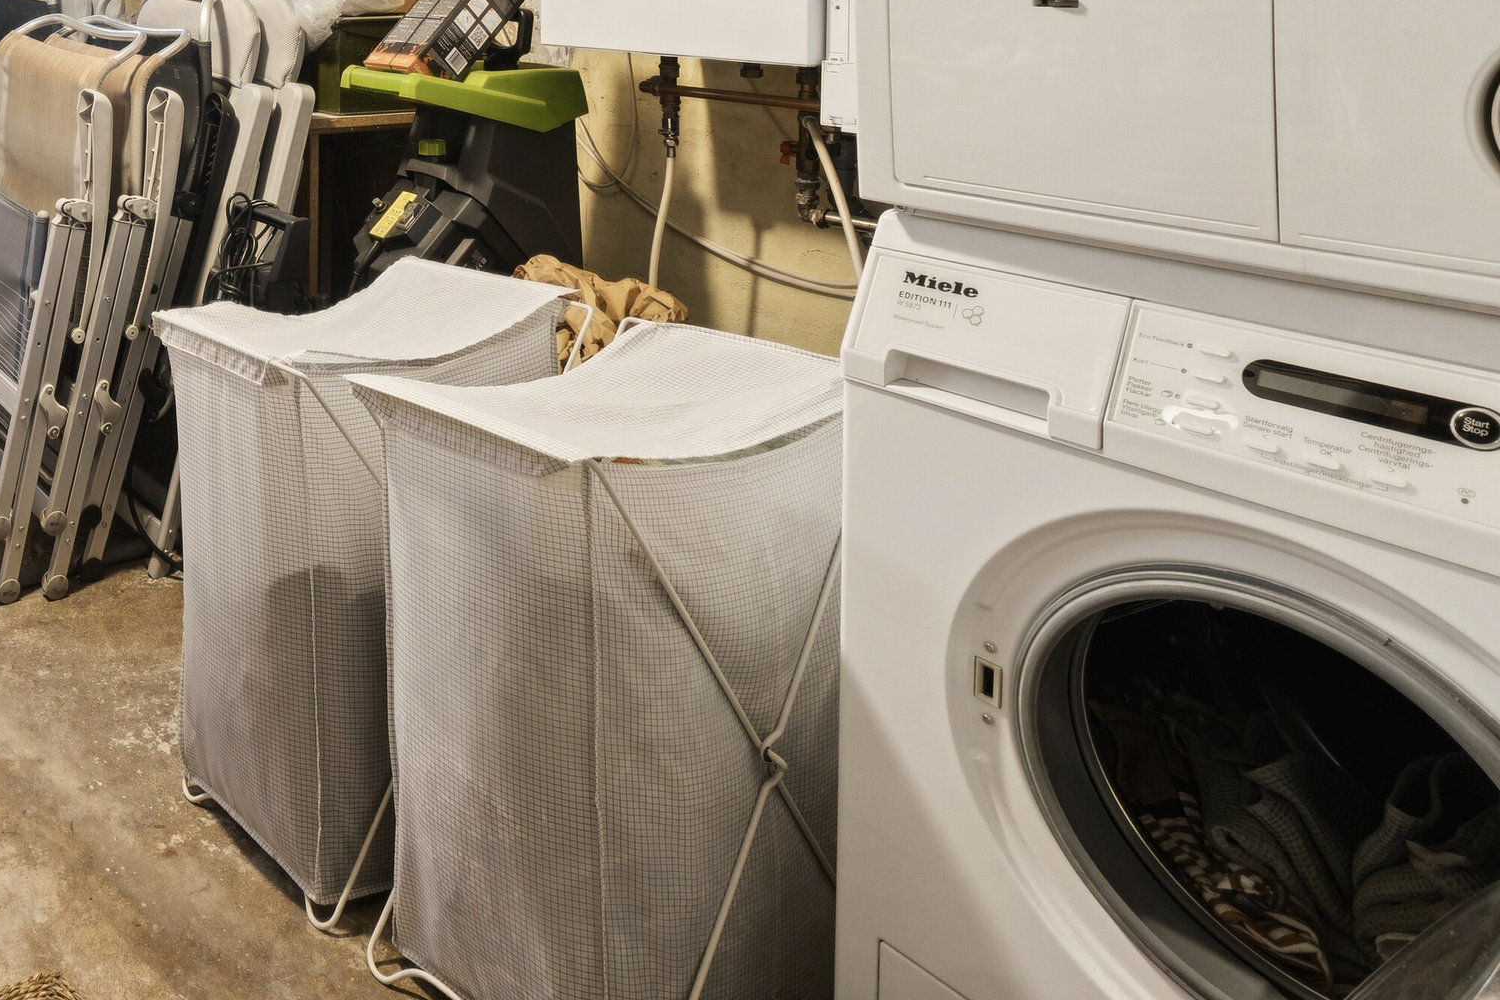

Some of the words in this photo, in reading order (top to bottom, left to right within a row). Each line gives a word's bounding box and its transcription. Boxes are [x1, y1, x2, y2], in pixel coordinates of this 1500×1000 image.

[903, 271, 978, 298] Miele
[899, 291, 937, 305] EDITION
[1153, 335, 1185, 346] Feedback
[1242, 421, 1271, 433] Senare
[1273, 428, 1292, 439] start
[1244, 415, 1294, 433] Startforvalg
[1463, 424, 1489, 437] Stop
[1464, 416, 1490, 429] Start
[1304, 436, 1352, 455] Temperatur
[1360, 431, 1436, 455] Centrifugerings-
[1374, 442, 1421, 458] hastighed
[1358, 444, 1434, 468] Centrifugerings-
[1378, 457, 1410, 470] varvtal
